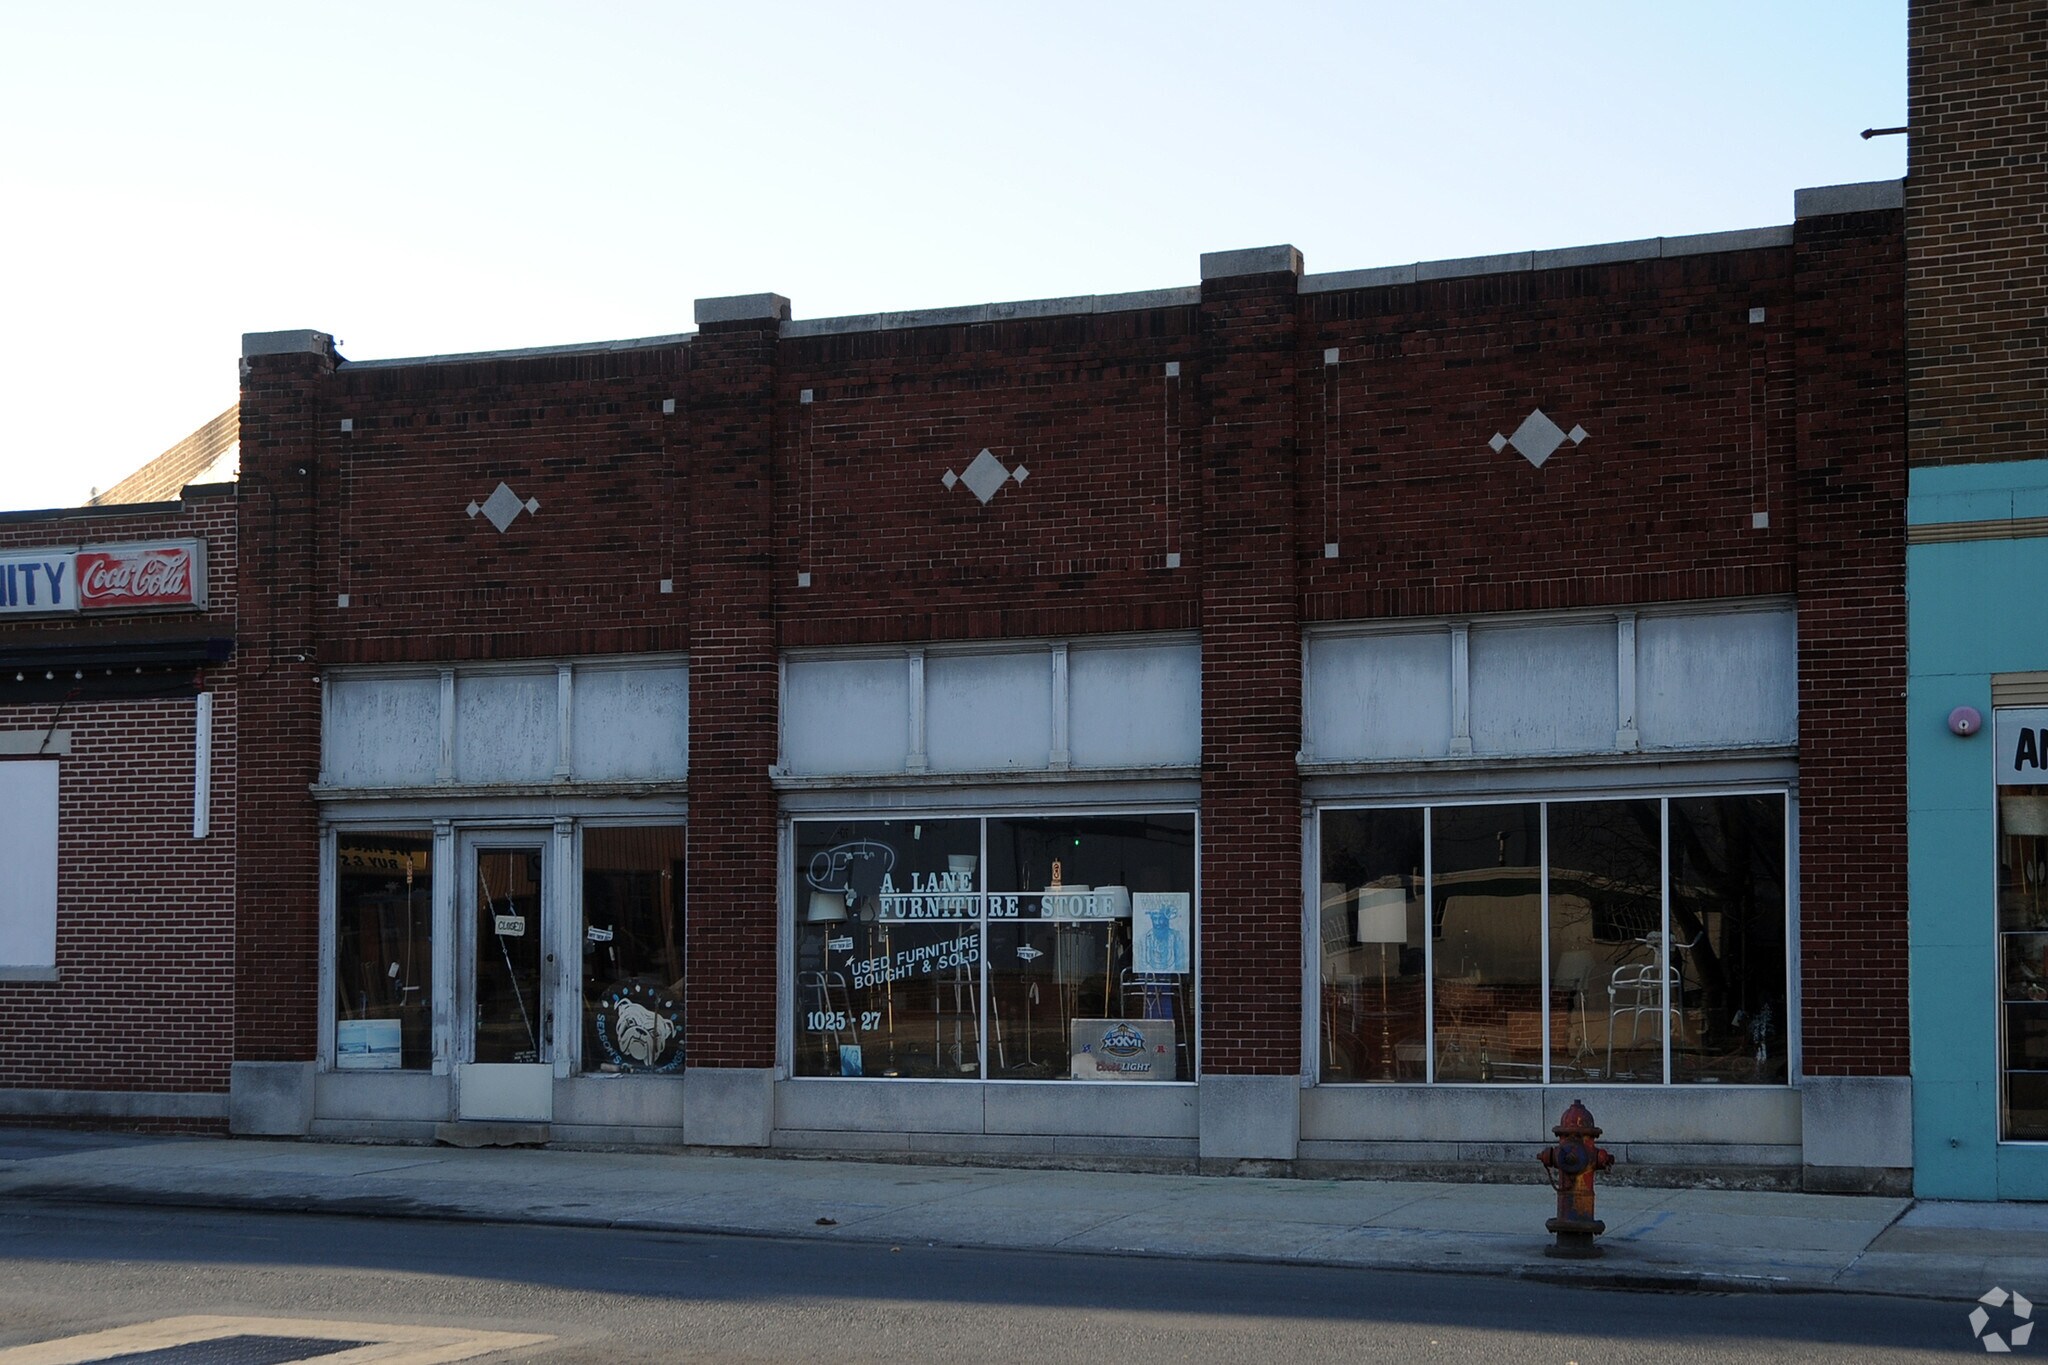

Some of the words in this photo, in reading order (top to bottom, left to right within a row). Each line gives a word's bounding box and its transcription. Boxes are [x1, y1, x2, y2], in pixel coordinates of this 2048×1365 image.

[0, 562, 65, 607] ITY
[880, 872, 900, 893] A.
[911, 872, 972, 893] LANE
[879, 896, 1018, 918] FURNITURE
[1041, 895, 1115, 917] STORE
[498, 921, 523, 931] CLOSED
[851, 956, 890, 976] USED
[896, 934, 979, 966] FURNITURE
[854, 963, 915, 990] BOUGHT
[922, 959, 931, 973] &
[939, 948, 979, 969] SOLD
[807, 1011, 846, 1030] 1025
[1121, 1062, 1151, 1072] LIGHT
